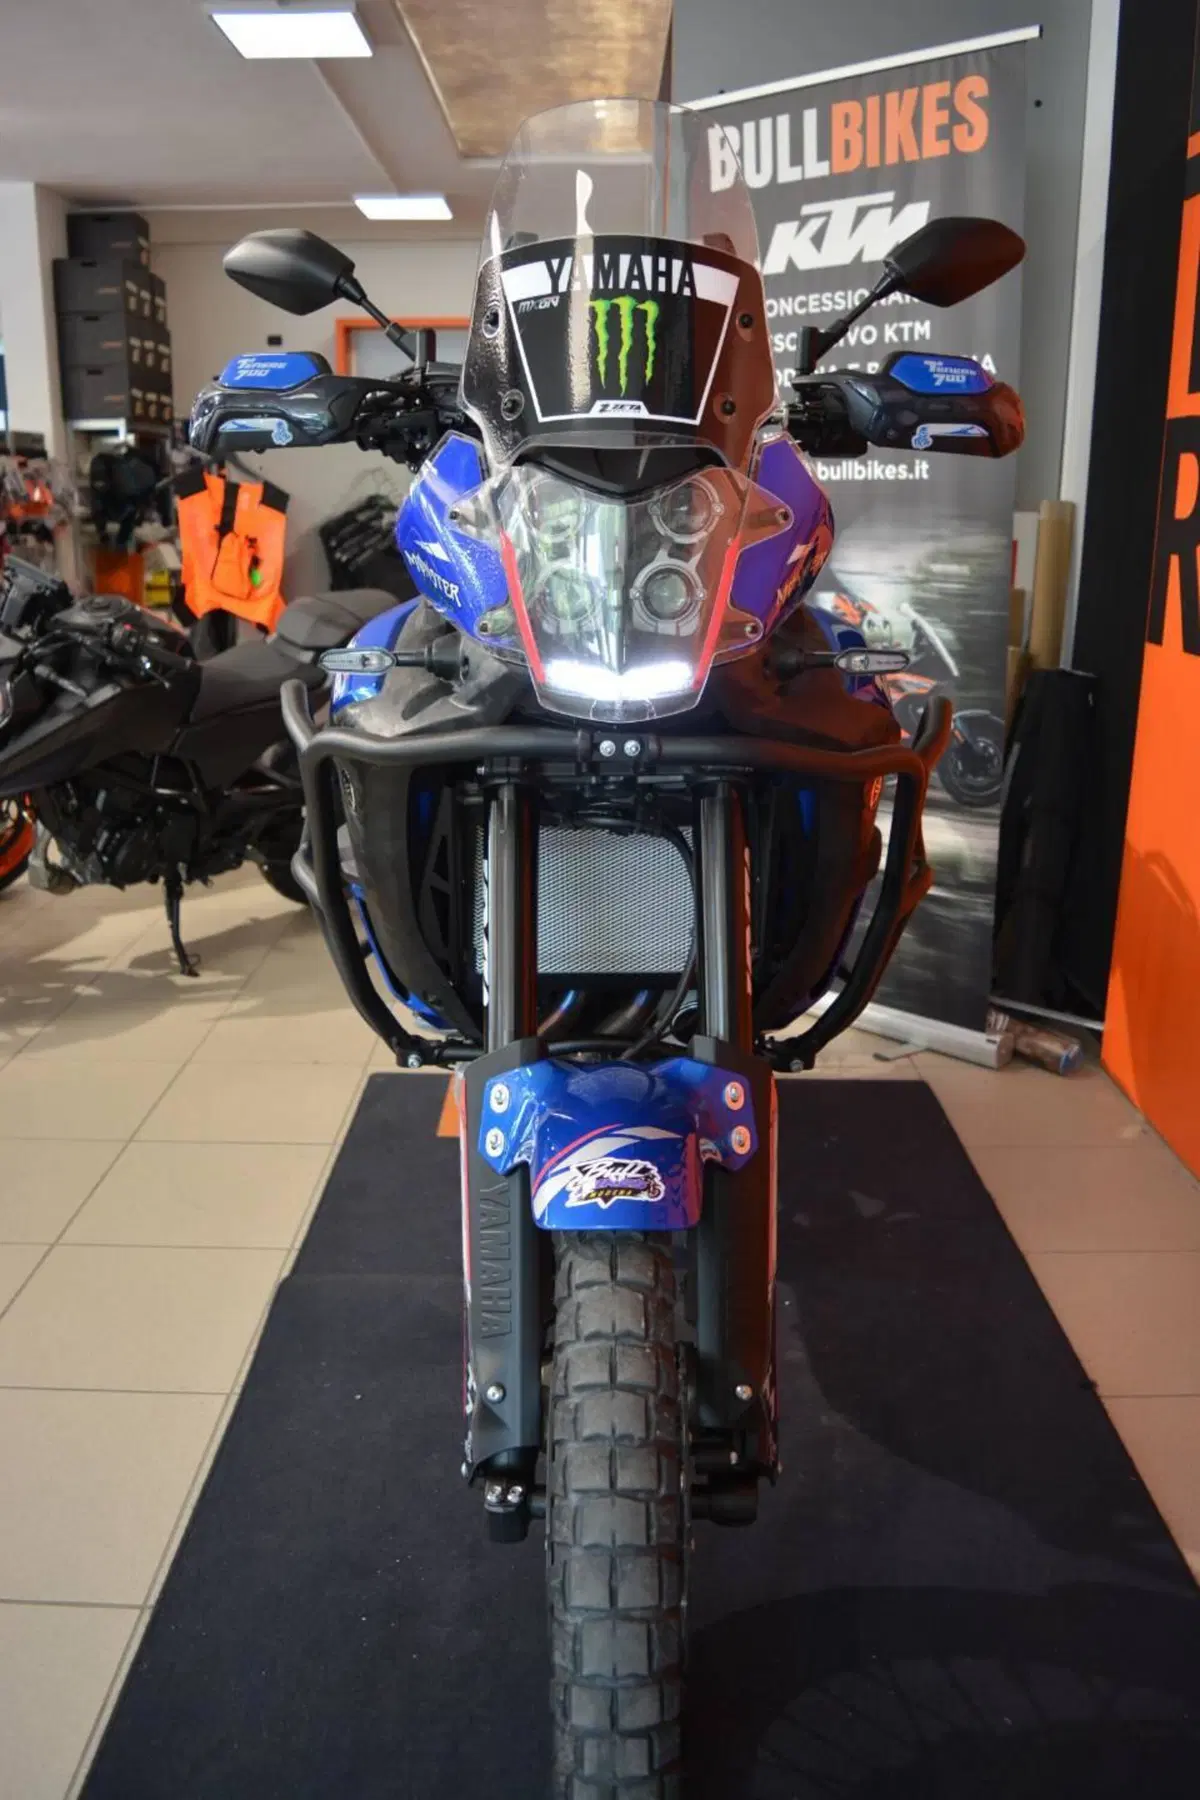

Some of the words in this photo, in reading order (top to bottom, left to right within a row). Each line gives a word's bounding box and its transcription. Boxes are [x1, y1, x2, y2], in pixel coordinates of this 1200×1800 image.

[707, 75, 989, 193] BULLBIKES
[763, 191, 930, 275] KTM
[543, 254, 699, 297] YAMAHA
[884, 320, 931, 344] KTM
[233, 369, 272, 380] 700
[932, 373, 967, 387] 700
[479, 1176, 512, 1340] YAMAHA
